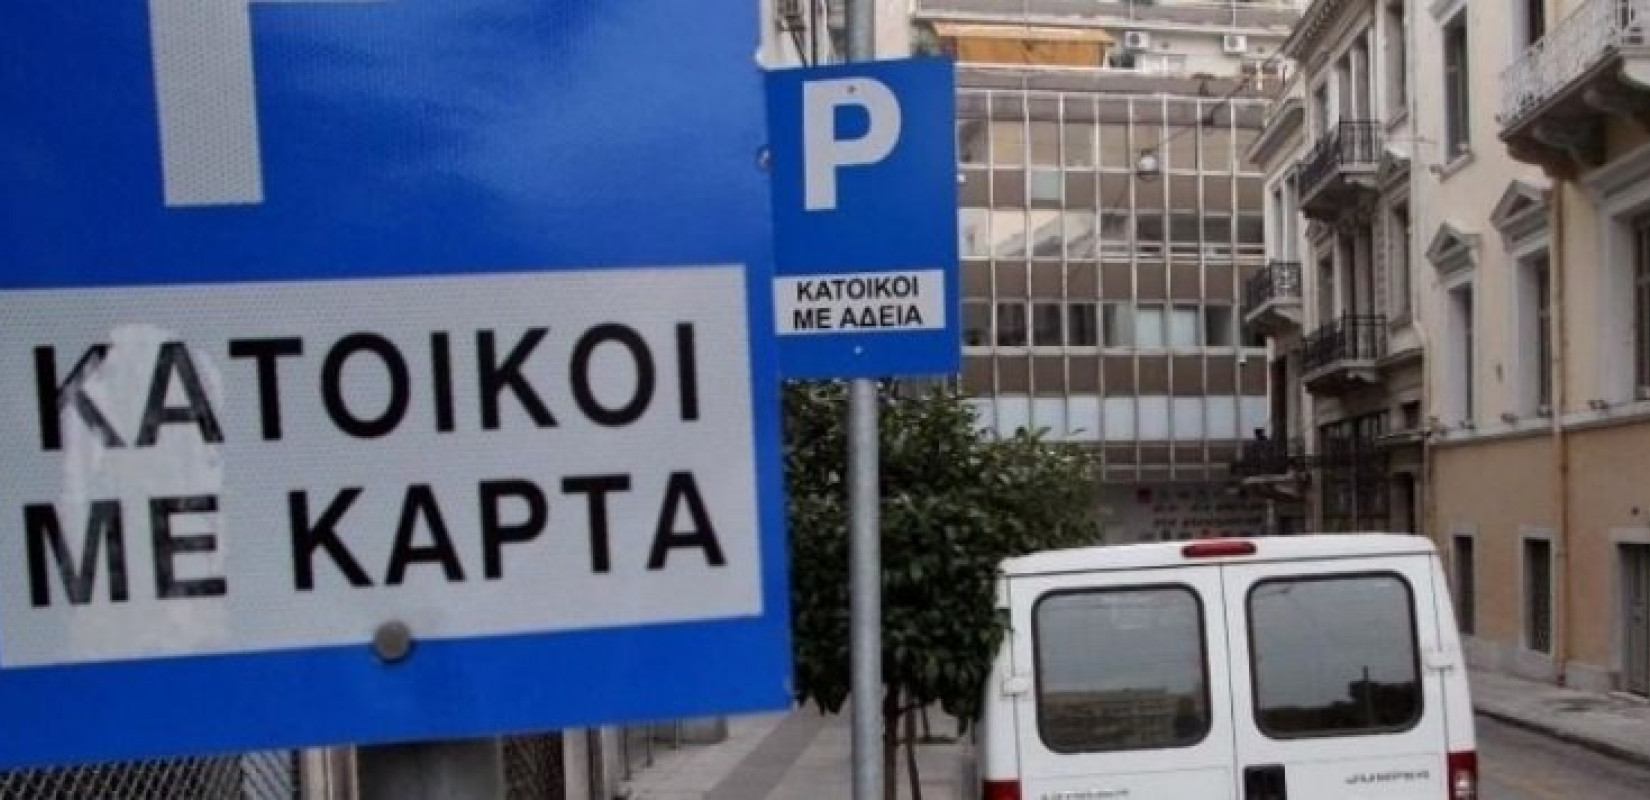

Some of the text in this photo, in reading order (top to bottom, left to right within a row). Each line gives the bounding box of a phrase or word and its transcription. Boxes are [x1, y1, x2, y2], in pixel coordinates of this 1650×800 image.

[803, 77, 902, 211] P
[793, 304, 924, 330] ΜΕ ΑΔΕΙΑ
[796, 275, 919, 302] ΚΑΤΟΙΚΟΙ
[33, 322, 700, 452] ΚΑΤΟΙΚΟΙ
[23, 470, 728, 608] ΜΕ ΚΑΡΤΑ
